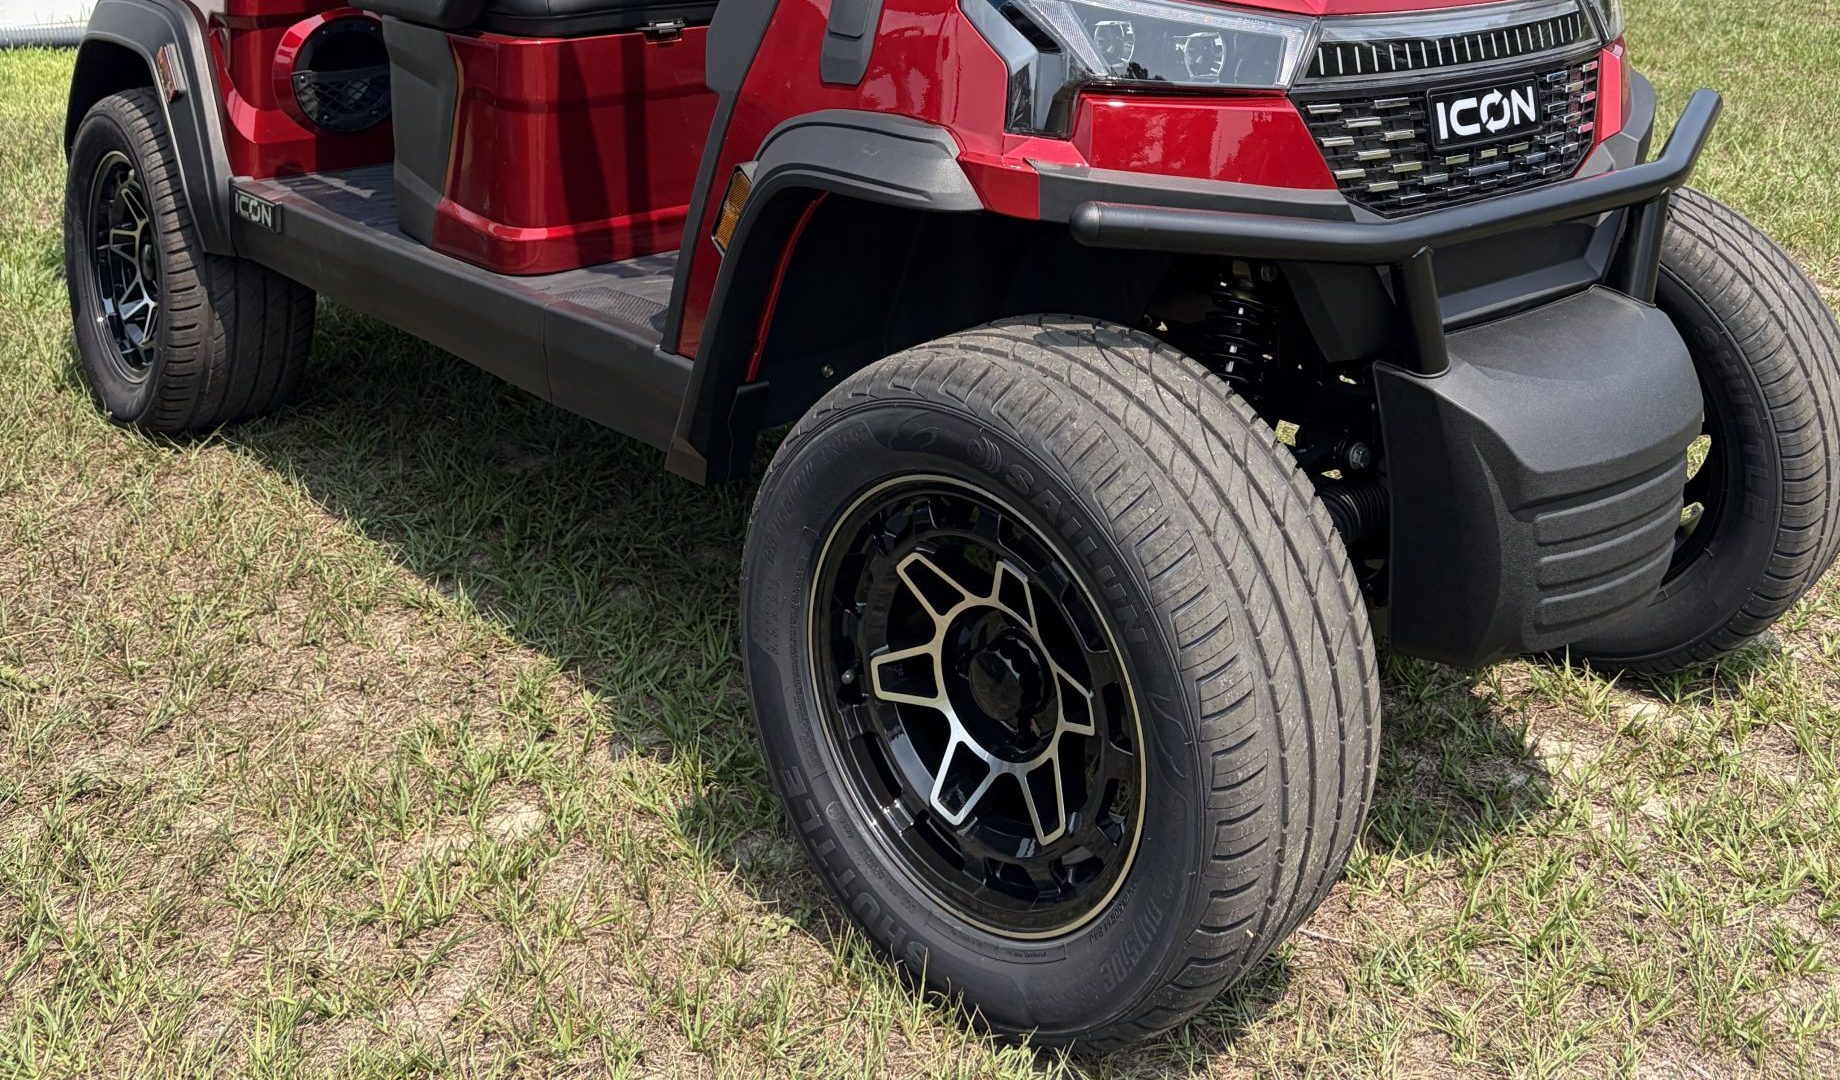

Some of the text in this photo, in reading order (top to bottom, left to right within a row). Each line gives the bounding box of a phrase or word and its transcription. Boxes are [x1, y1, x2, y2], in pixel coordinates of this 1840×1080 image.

[1436, 86, 1536, 140] ICON
[235, 192, 272, 227] ICON
[1698, 324, 1769, 519] SHUTTLE
[1006, 464, 1149, 643] SAILUN
[779, 766, 931, 970] SHUTTLE
